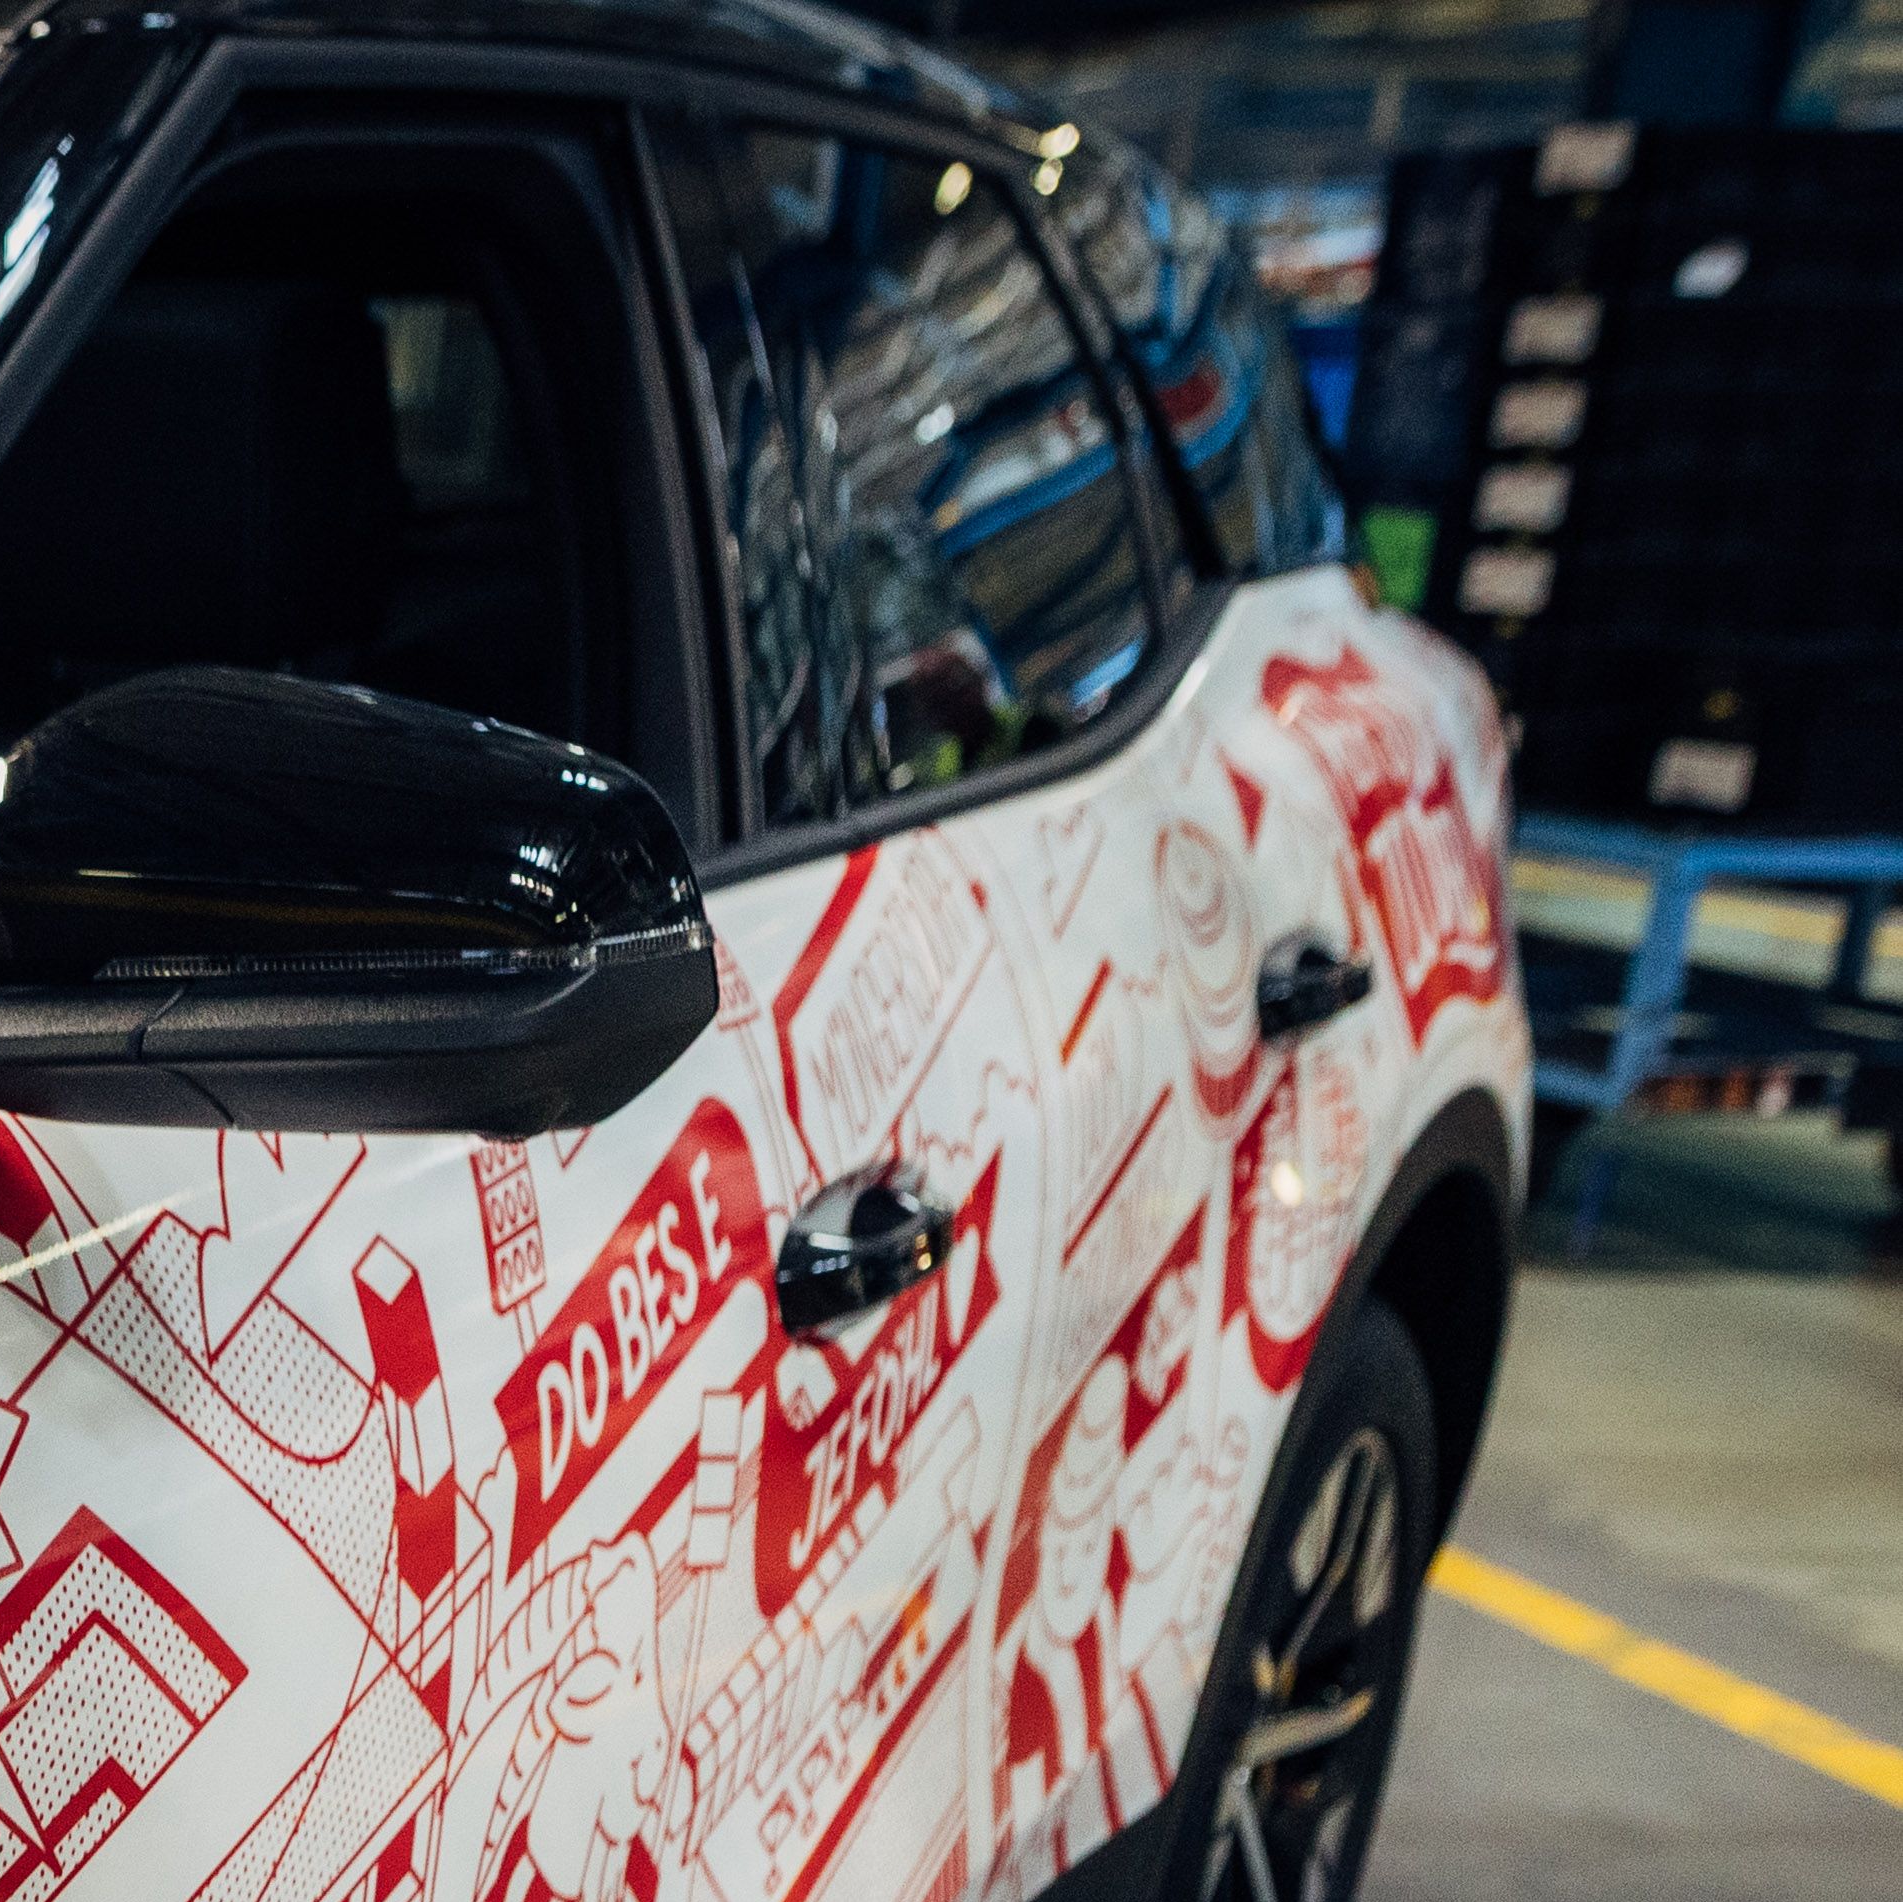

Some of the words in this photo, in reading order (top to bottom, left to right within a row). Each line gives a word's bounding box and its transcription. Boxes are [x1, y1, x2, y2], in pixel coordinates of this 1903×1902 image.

[536, 1321, 610, 1503] DO
[608, 1200, 699, 1401] BES
[688, 1149, 732, 1283] E
